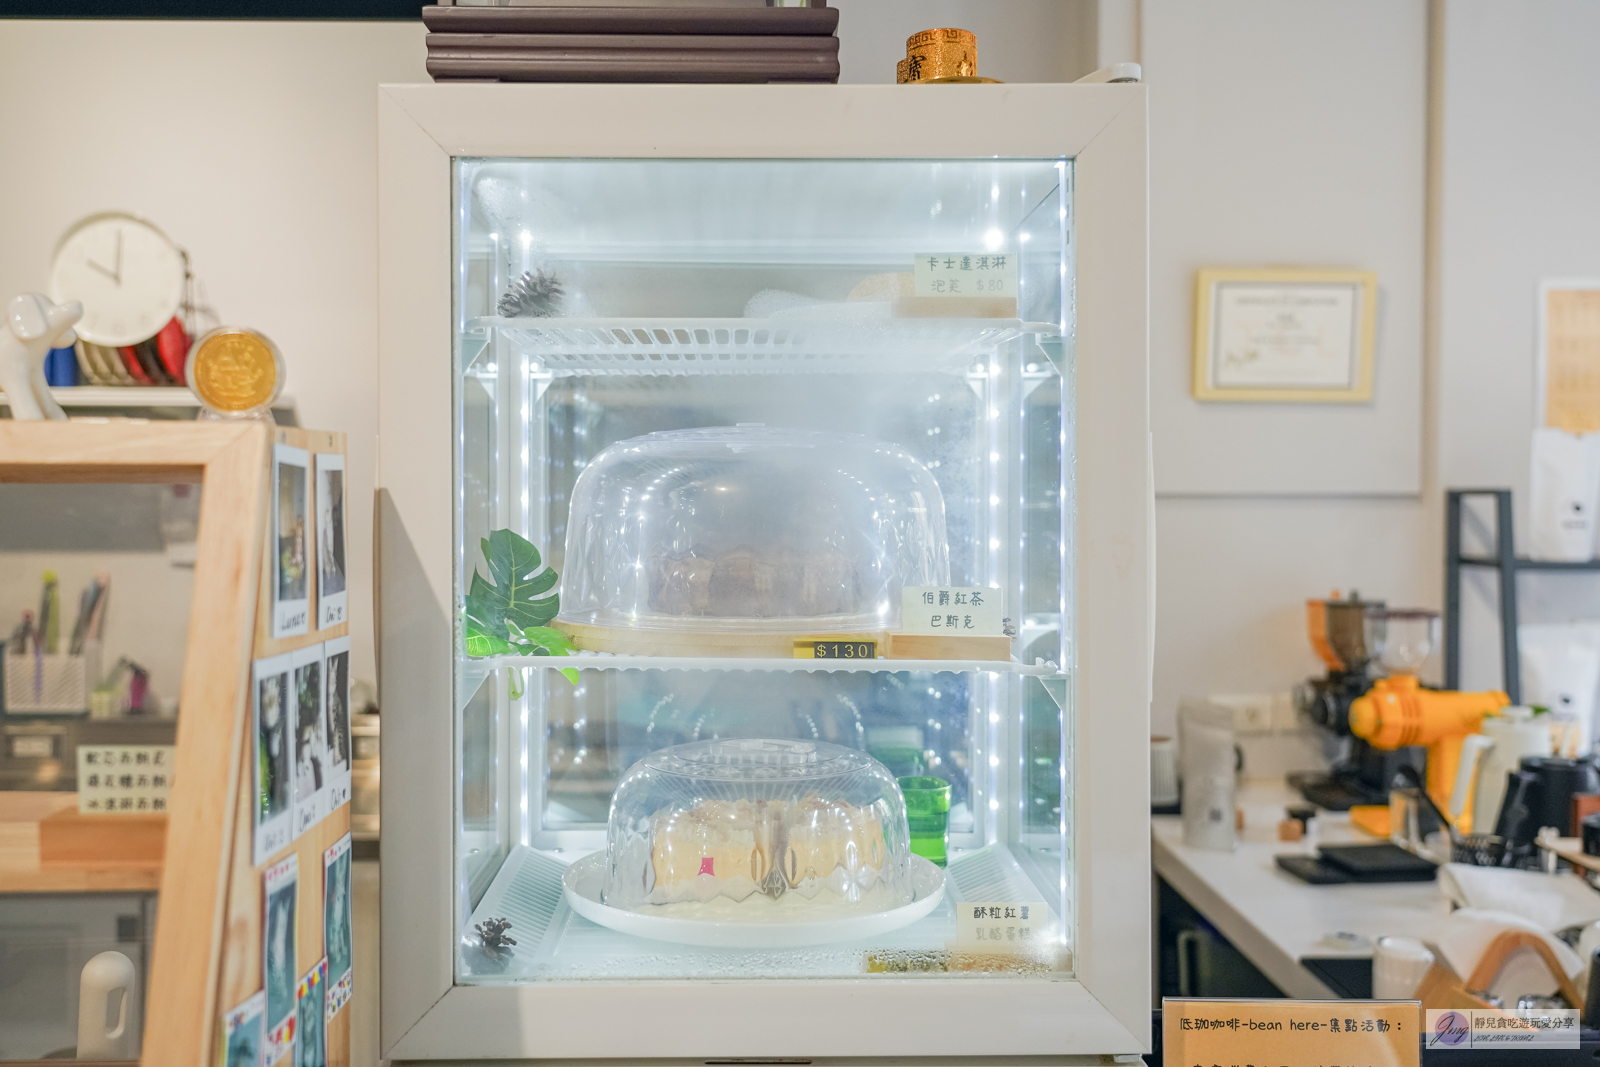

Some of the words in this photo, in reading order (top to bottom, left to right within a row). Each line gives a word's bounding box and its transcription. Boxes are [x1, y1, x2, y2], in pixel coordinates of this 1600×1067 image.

[976, 278, 1004, 292] $80
[922, 590, 984, 607] 伯爵紅茶
[930, 614, 975, 629] 巴斯克
[816, 643, 868, 659] $130
